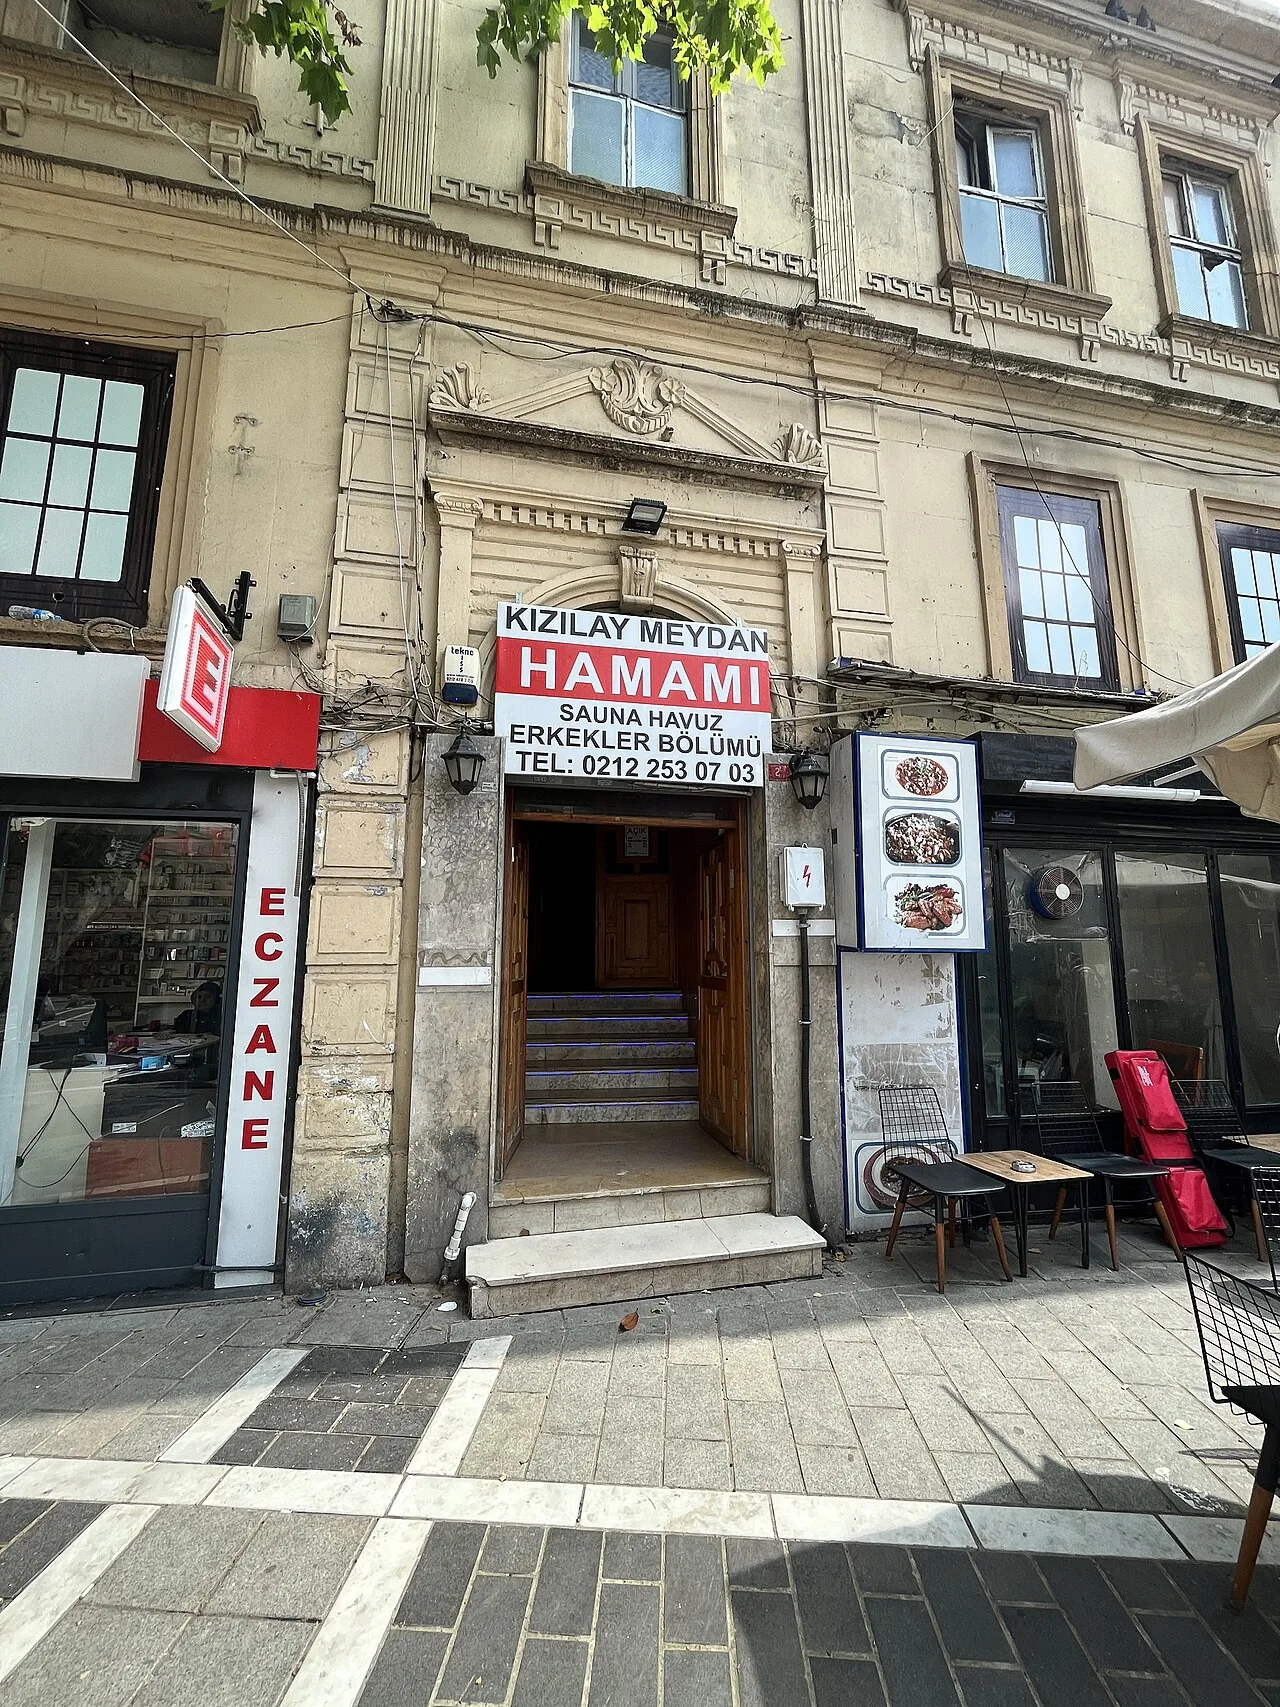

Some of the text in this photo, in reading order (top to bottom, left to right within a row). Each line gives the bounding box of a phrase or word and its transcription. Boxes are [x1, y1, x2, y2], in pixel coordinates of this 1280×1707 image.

[505, 605, 768, 653] KIZILAY MEYDAN
[520, 646, 760, 705] HAMAMI
[559, 703, 723, 731] SAUNA HAVUZ
[510, 723, 761, 757] ERKEKLER BÖLÜMÜ
[515, 750, 755, 783] TEL: 0212 253 07 03
[627, 827, 647, 836] AÇIK
[241, 887, 287, 1150] ECZANE
